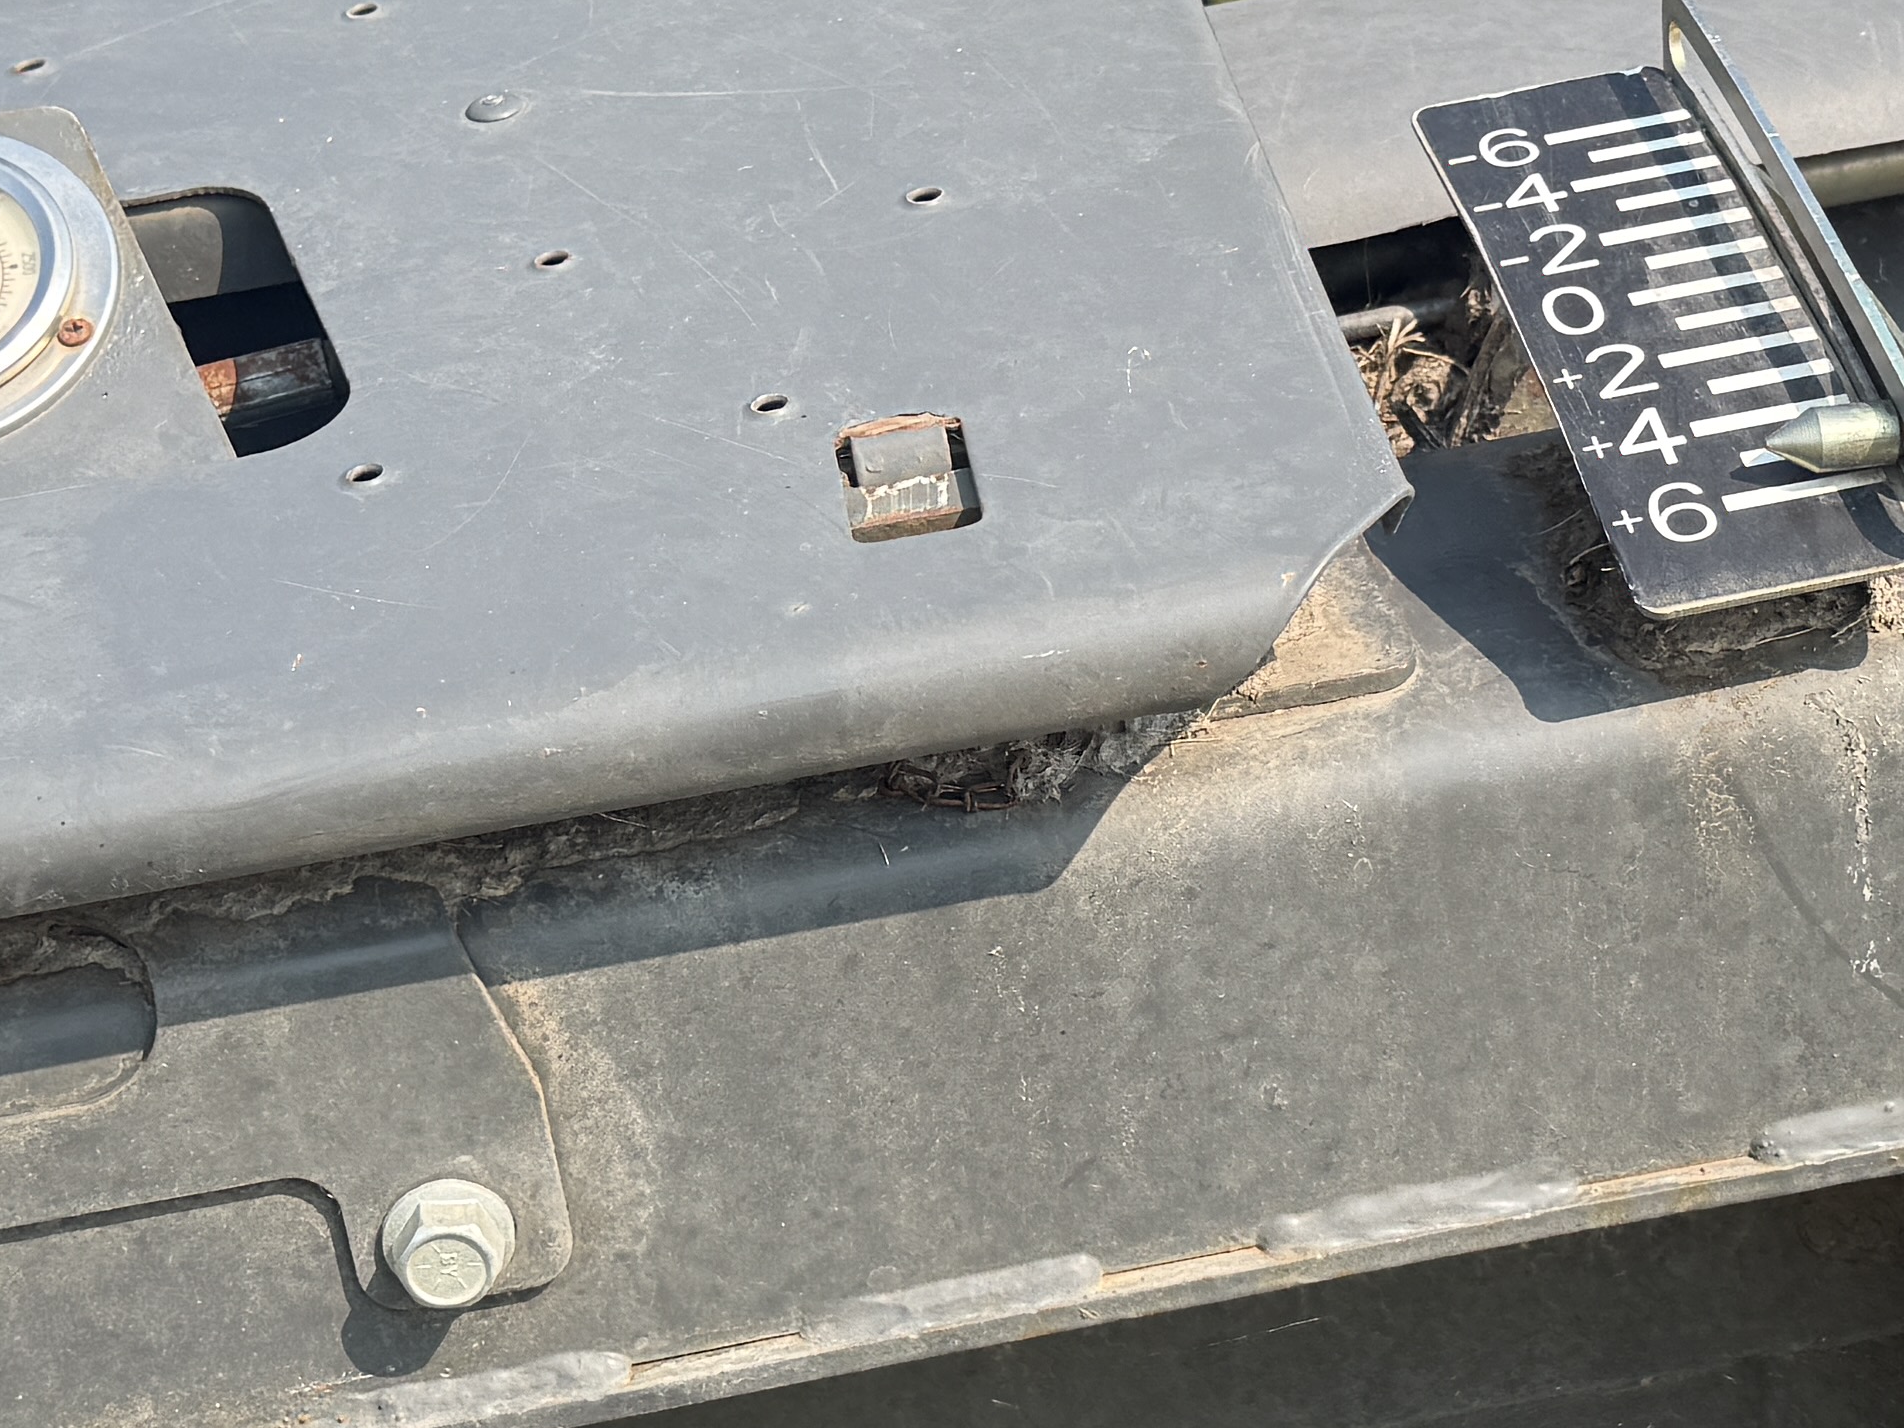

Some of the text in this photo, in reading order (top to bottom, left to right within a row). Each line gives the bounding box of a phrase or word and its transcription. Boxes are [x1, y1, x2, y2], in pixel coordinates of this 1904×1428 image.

[1447, 127, 1541, 168] -6
[1472, 172, 1569, 213] -4
[1499, 223, 1601, 276] -2
[1541, 285, 1606, 336] 0
[1552, 343, 1660, 400] +2
[1581, 406, 1688, 466] +4
[1611, 481, 1719, 543] +6
